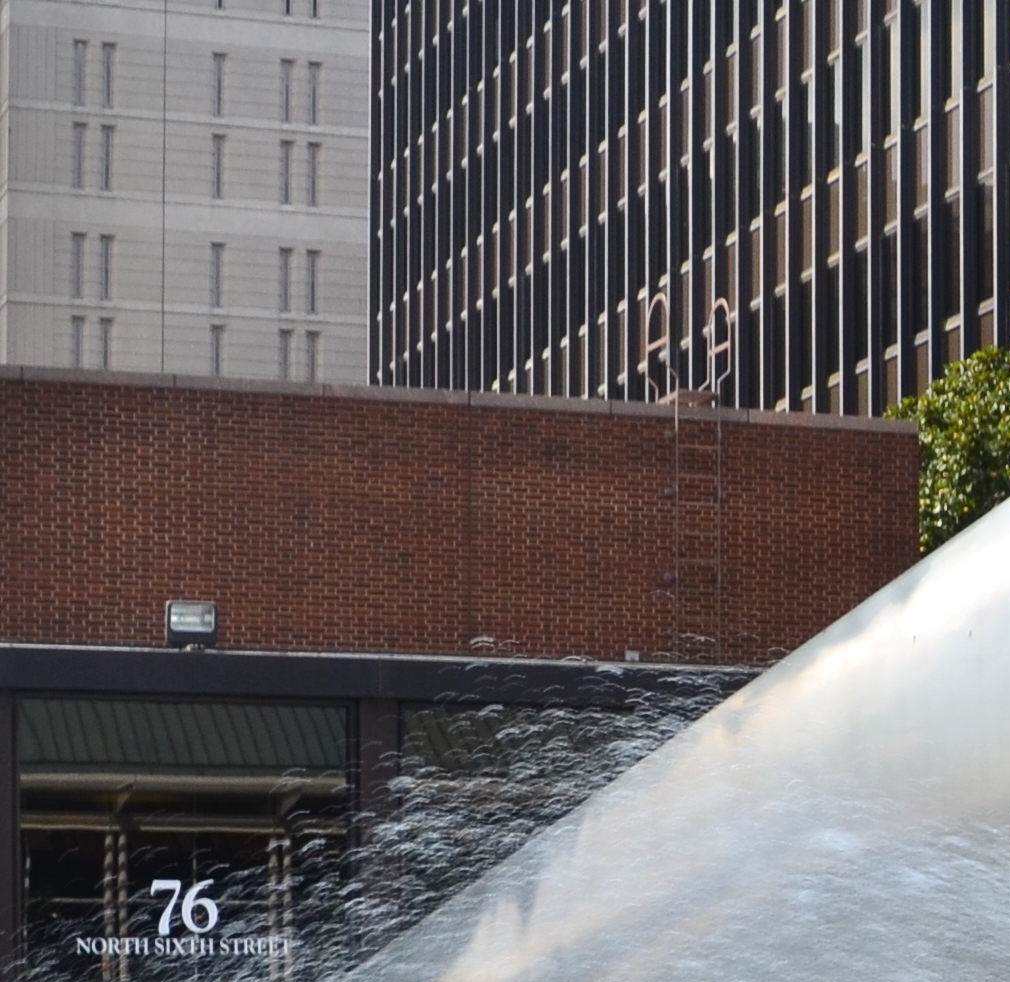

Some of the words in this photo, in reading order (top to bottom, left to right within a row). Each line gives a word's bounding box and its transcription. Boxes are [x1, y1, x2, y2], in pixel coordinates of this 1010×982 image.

[150, 878, 219, 936] 76
[76, 937, 149, 955] NORTH
[154, 937, 214, 956] SIXTH
[219, 937, 291, 955] STREET
